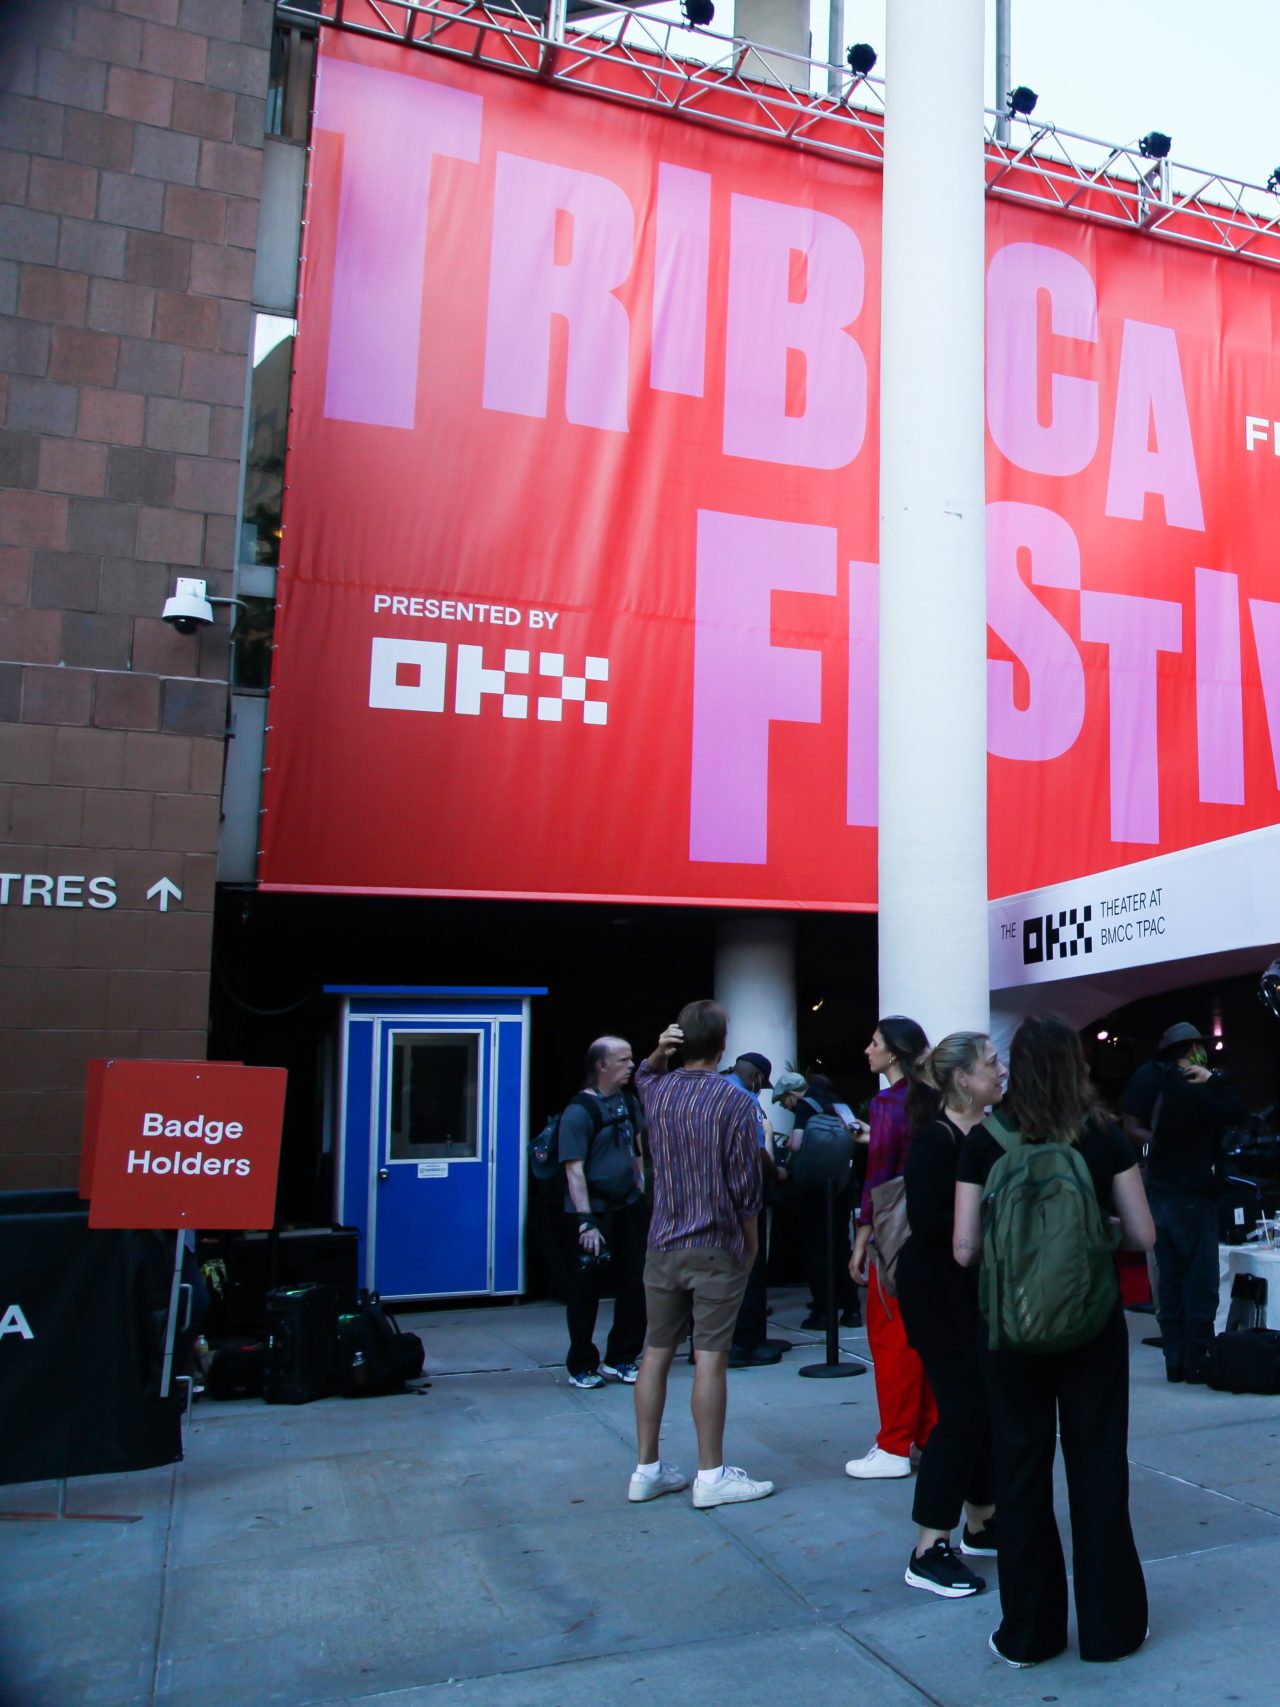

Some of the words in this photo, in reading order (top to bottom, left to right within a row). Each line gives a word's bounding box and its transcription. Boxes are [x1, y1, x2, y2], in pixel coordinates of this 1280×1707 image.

[315, 56, 1205, 532] TRIBCA
[374, 594, 521, 626] PRESENTED
[529, 610, 558, 629] BY
[369, 637, 609, 725] OKX
[0, 873, 117, 909] TRES
[1001, 923, 1016, 940] THE
[1023, 905, 1093, 965] OKX
[1101, 893, 1146, 918] THEATER
[1150, 888, 1162, 908] AT
[1101, 923, 1133, 946] BMCC
[1136, 916, 1166, 939] TPAC
[142, 1112, 243, 1145] Badge
[127, 1149, 251, 1176] Holders
